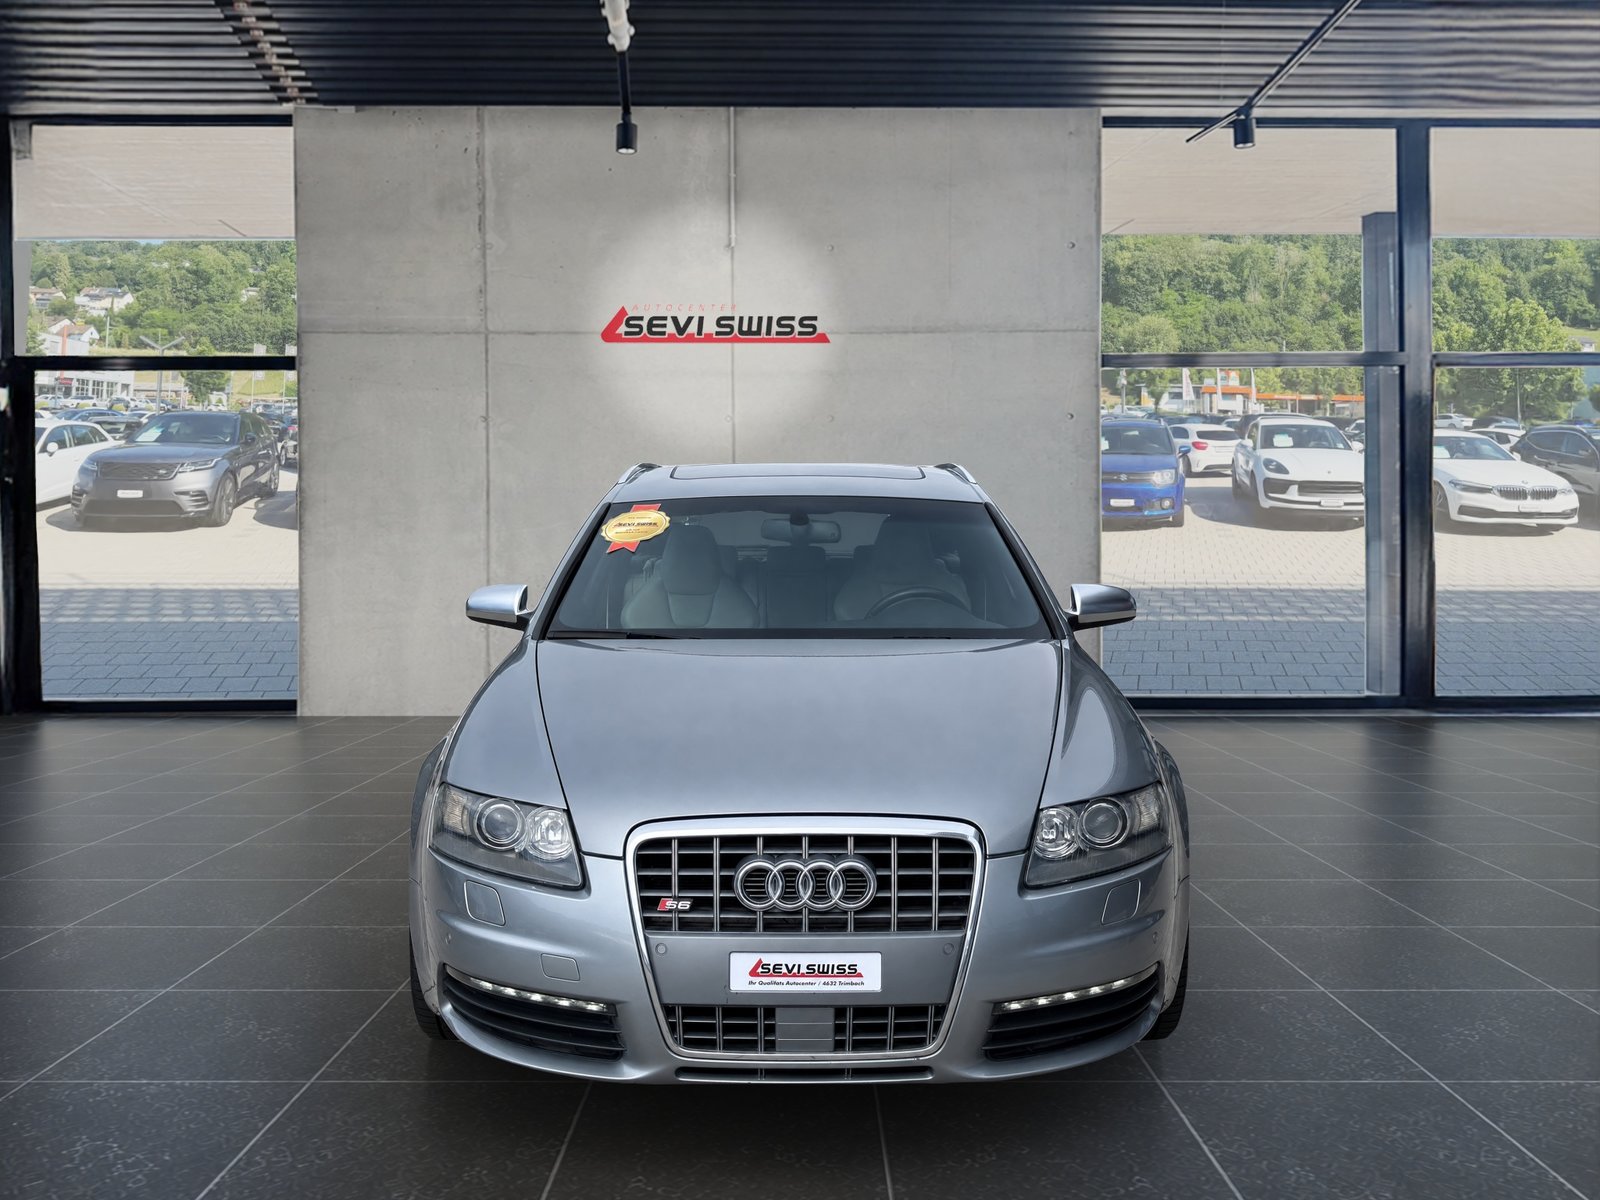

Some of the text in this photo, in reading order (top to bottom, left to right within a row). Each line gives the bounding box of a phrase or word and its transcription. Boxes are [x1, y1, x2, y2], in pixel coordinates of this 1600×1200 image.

[632, 303, 737, 312] AUTOCENTER
[623, 316, 818, 337] SEVI SWISS
[665, 900, 691, 910] S6
[760, 963, 858, 975] SEVI SWISS
